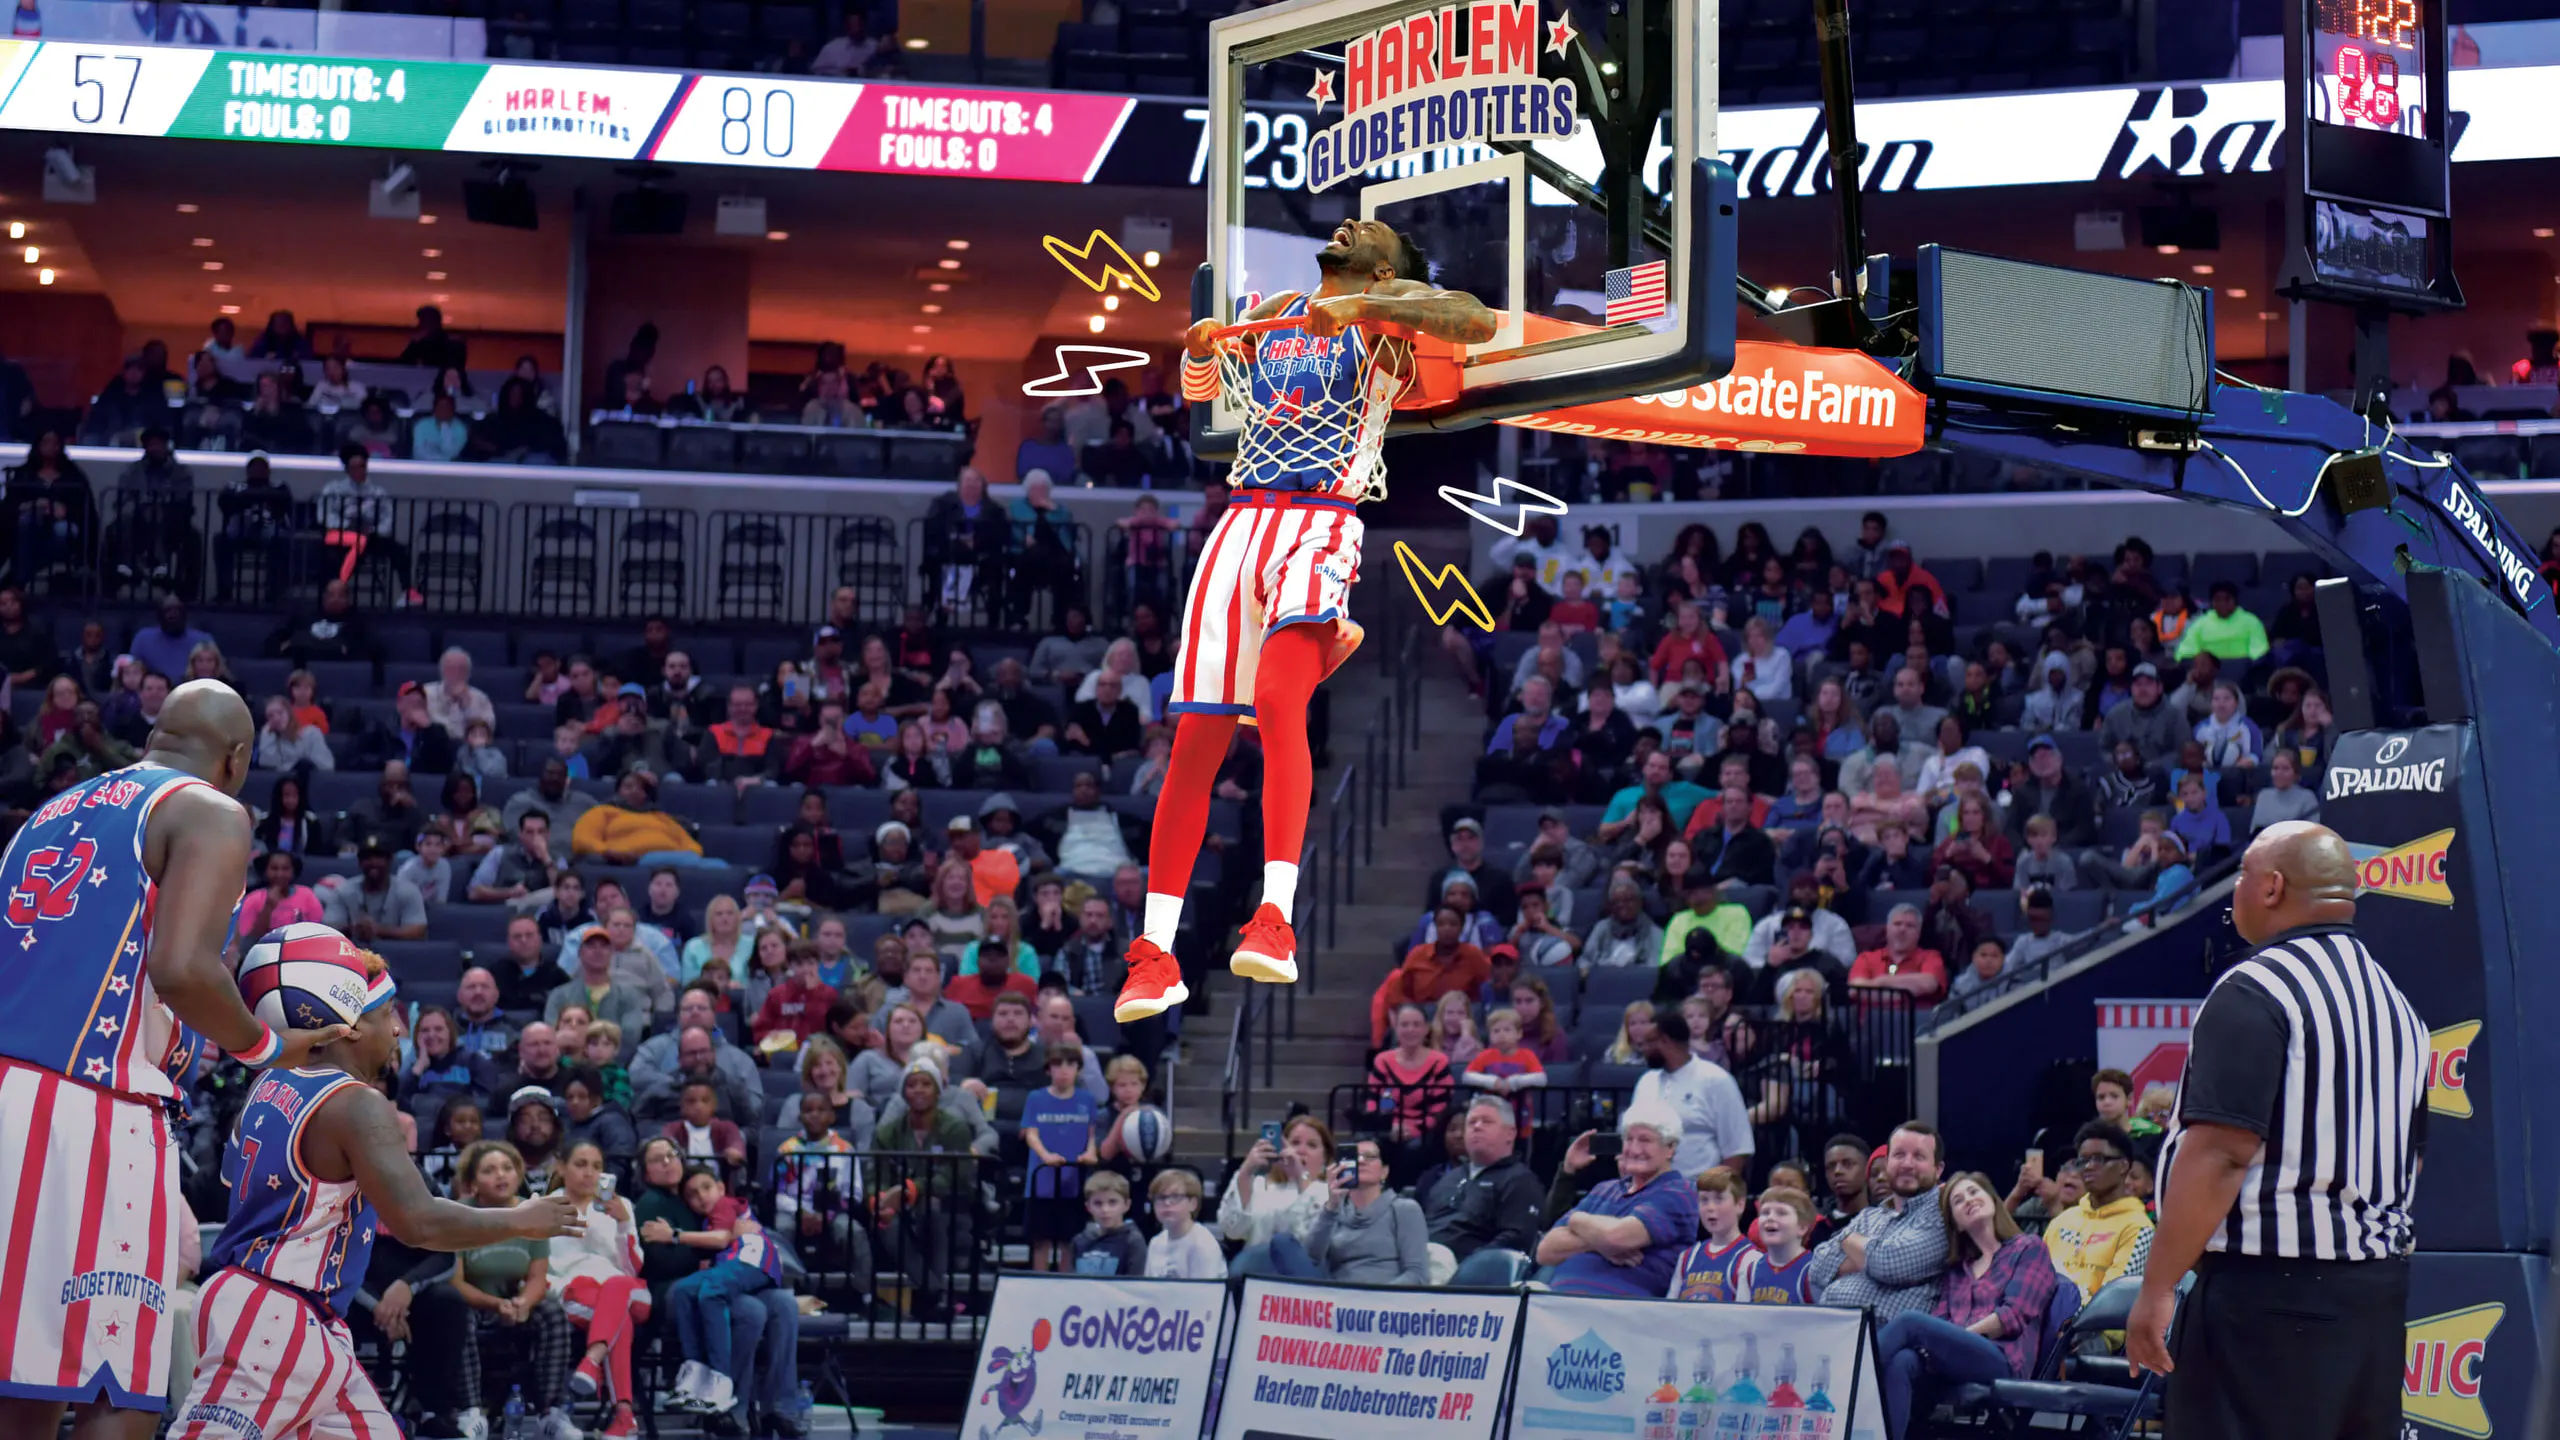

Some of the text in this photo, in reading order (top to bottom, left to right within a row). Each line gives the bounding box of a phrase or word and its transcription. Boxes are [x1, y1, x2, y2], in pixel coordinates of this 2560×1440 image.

[227, 61, 406, 103] TIMEOUTS: 4
[1346, 4, 1535, 115] HARLEM
[72, 54, 142, 125] 57
[506, 88, 611, 116] HARLEM
[223, 102, 350, 141] FOULS: 0
[721, 87, 794, 158] 80
[882, 96, 1054, 136] TIMEOUTS: 4
[1311, 84, 1573, 187] GLOBETROTTERS
[879, 135, 998, 171] FOULS: 0
[1183, 108, 1308, 190] 723
[1580, 524, 1620, 549] 11
[2442, 481, 2536, 602] SPALDING
[2326, 758, 2446, 800] SPALDING
[32, 789, 86, 829] BIG
[4, 837, 98, 928] 52
[271, 1083, 304, 1125] TALL
[239, 1135, 262, 1204] 7
[60, 1270, 166, 1315] GLOBETROTTERS
[1060, 1305, 1204, 1354] GoNoodle
[1258, 1294, 1504, 1342] ENHANCE your experience by
[1256, 1334, 1489, 1382] DOWNLOADING The Original
[1546, 1357, 1625, 1393] YUMMIES
[1062, 1373, 1180, 1405] PLAY AT HOME!
[1253, 1374, 1474, 1421] Harlem Globetrotters APP.
[1059, 1410, 1086, 1422] Create
[1088, 1414, 1107, 1424] your
[1108, 1413, 1128, 1425] FREE
